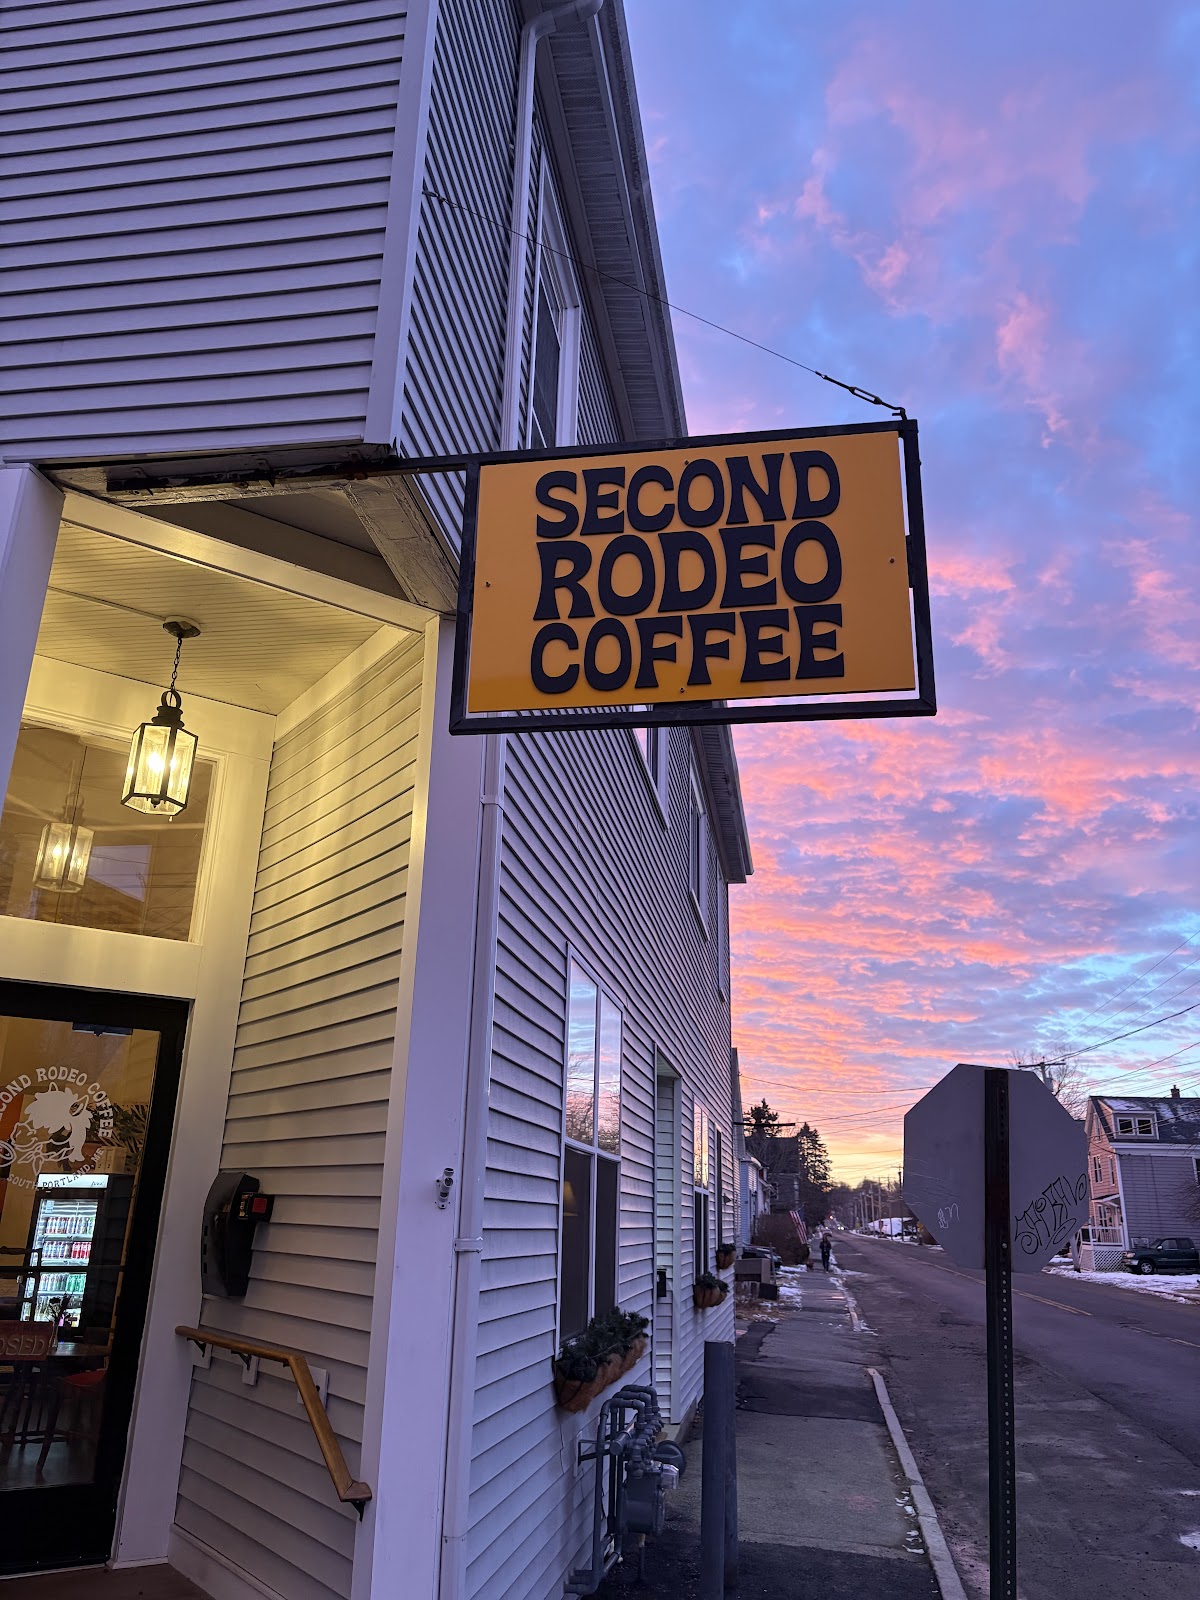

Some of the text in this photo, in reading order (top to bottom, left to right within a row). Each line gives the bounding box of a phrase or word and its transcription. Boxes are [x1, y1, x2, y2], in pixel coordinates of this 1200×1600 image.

[536, 450, 841, 538] SECOND
[533, 520, 843, 620] RODEO
[530, 604, 845, 694] COFFEE
[36, 1066, 87, 1086] RODEO
[87, 1082, 114, 1138] COFFEE
[7, 1173, 39, 1191] SOUTH
[91, 1147, 104, 1164] ME
